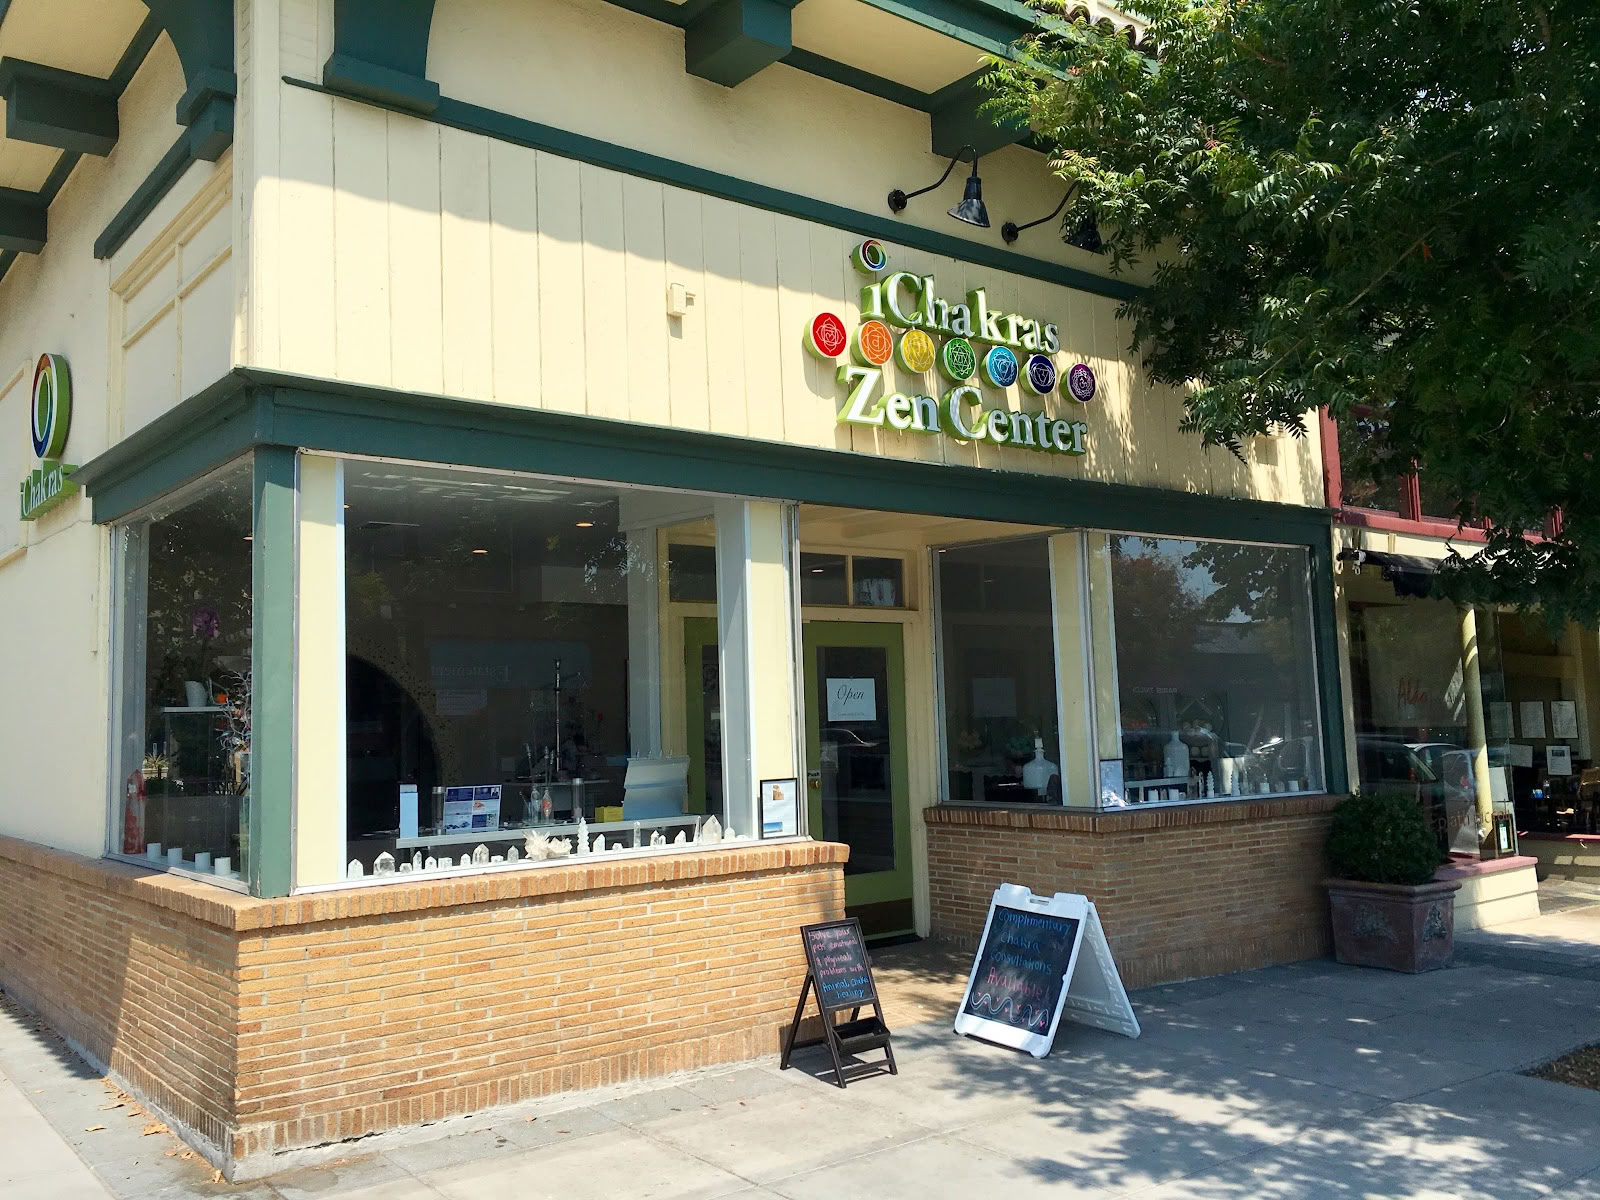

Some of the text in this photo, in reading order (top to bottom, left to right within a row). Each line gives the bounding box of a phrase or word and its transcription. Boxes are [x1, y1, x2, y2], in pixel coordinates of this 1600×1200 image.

[861, 271, 1060, 354] iChakras
[837, 364, 1088, 456] Zen Center
[837, 684, 865, 706] Open
[1000, 931, 1041, 953] Chakra
